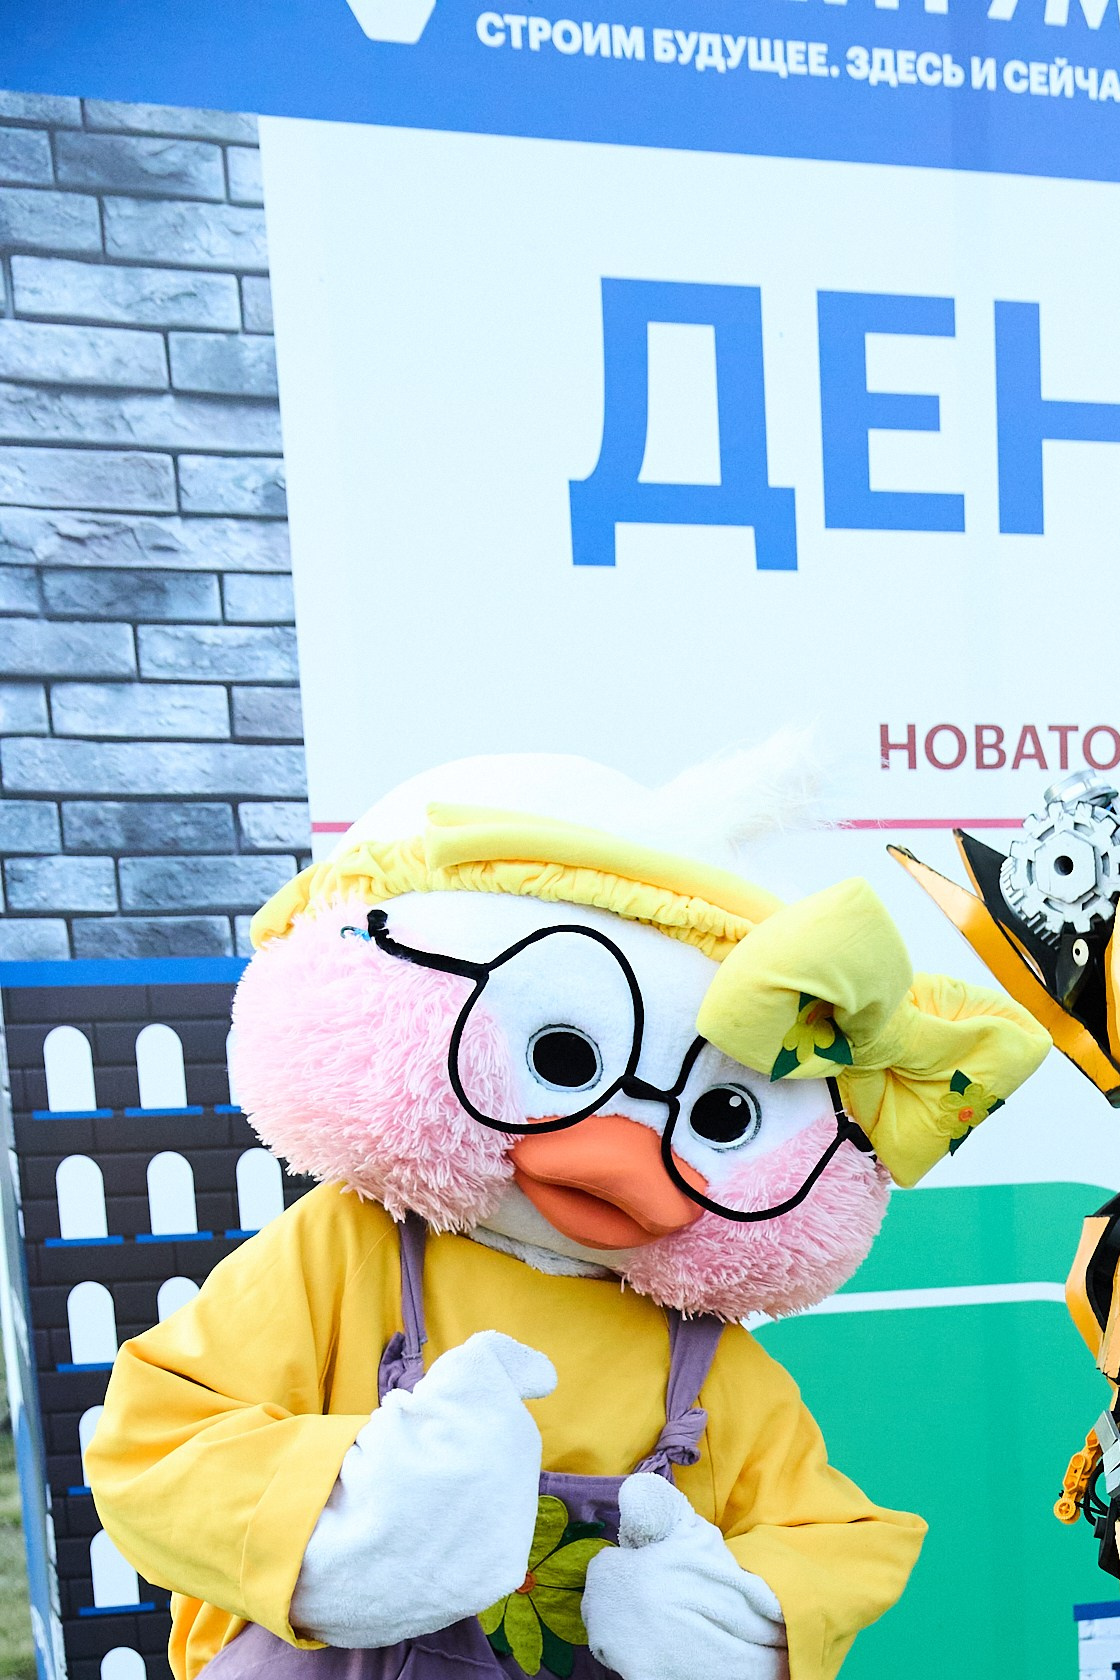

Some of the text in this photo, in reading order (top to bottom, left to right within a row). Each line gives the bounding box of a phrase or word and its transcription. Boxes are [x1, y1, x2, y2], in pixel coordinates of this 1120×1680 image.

[476, 11, 646, 62] СТРОИМ
[652, 27, 840, 79] БУДУЩЕЕ.
[846, 45, 966, 88] ЗДЕСЬ
[971, 55, 998, 91] И
